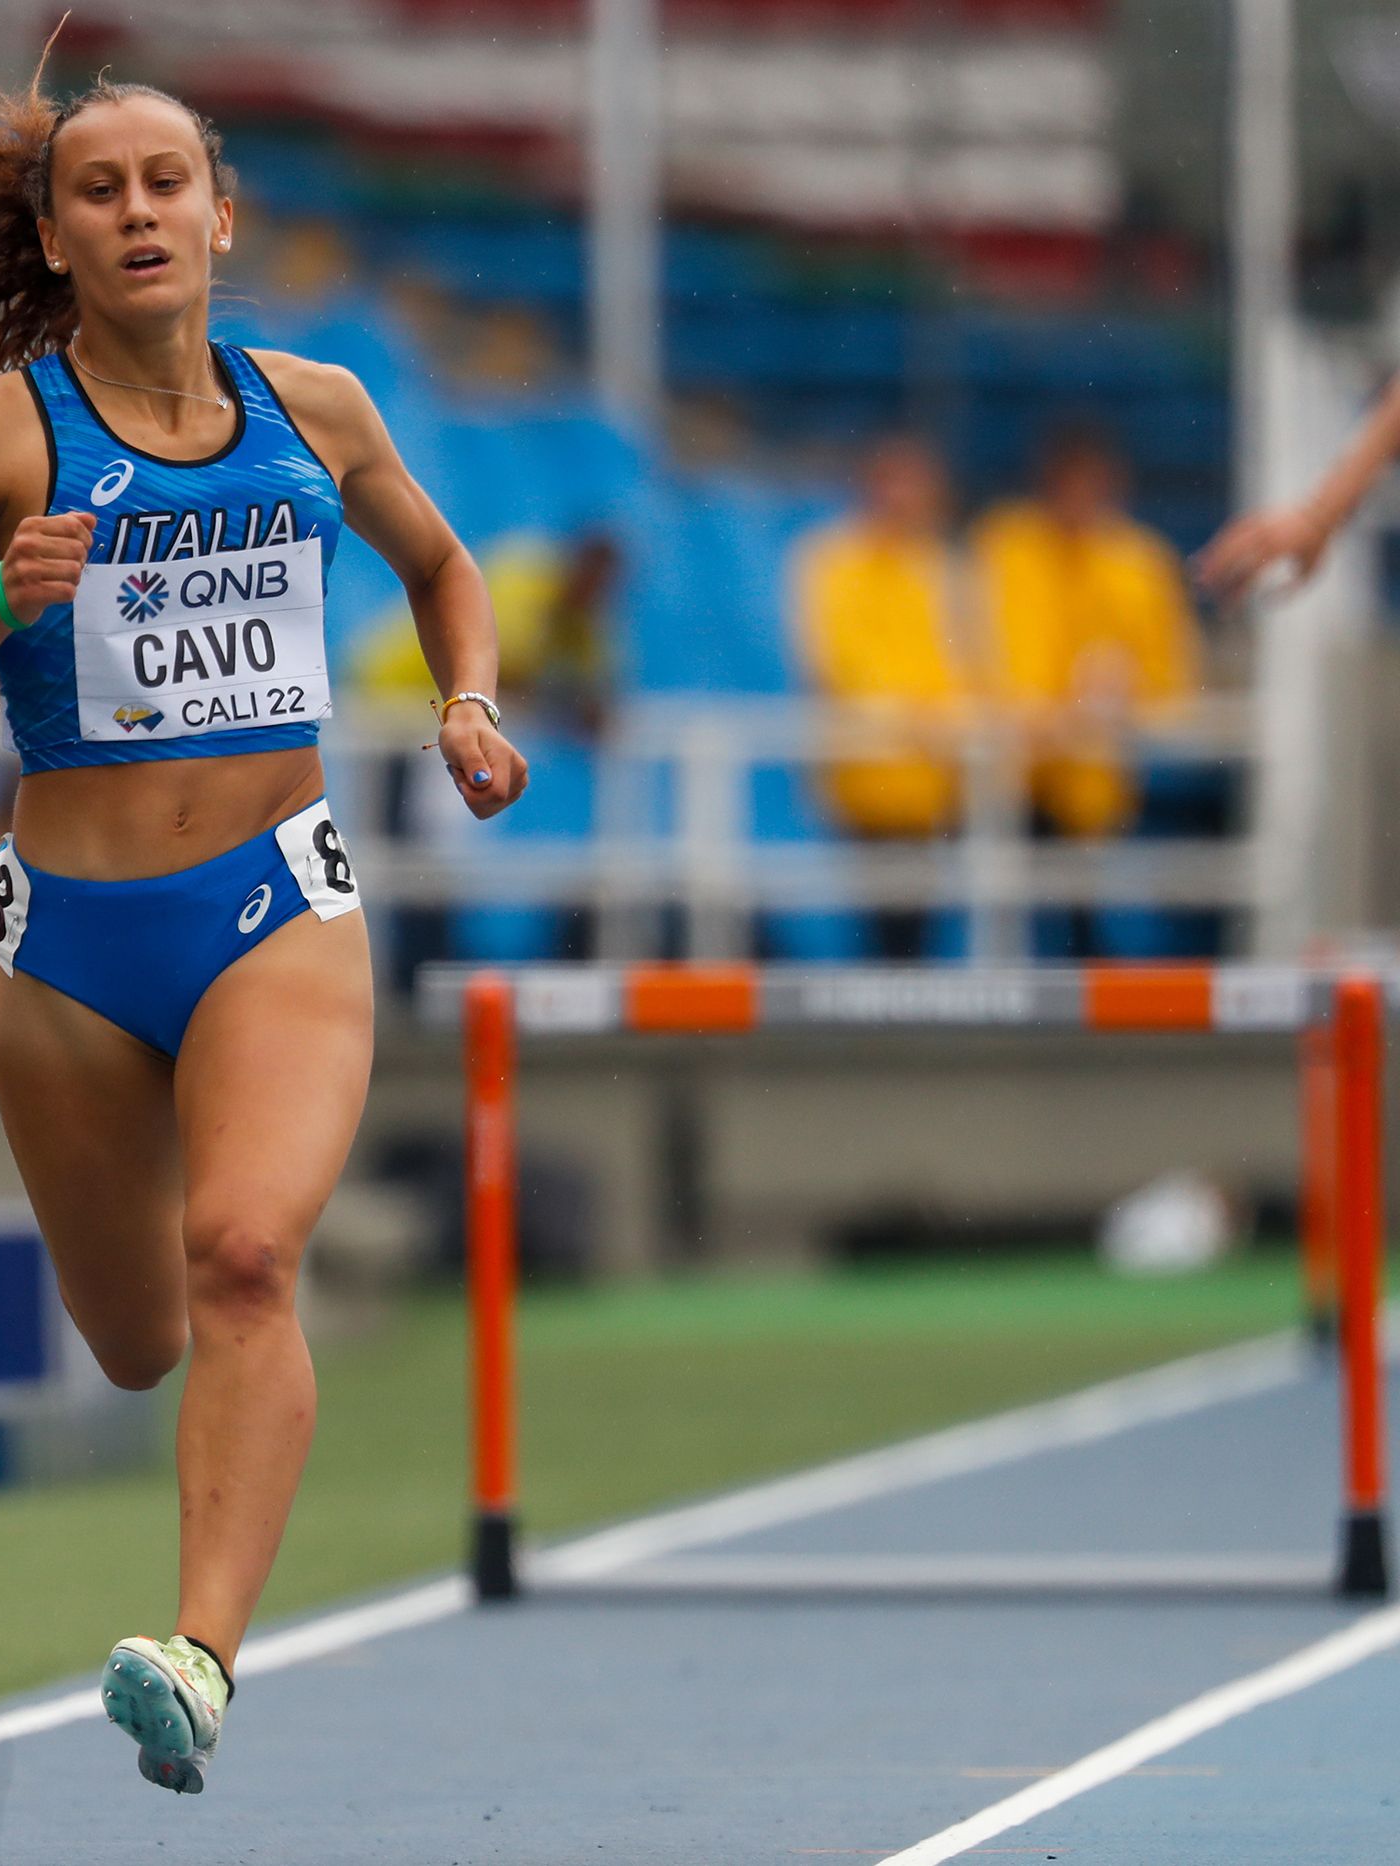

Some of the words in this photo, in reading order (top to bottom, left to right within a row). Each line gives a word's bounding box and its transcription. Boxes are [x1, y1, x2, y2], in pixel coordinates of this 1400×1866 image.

[108, 501, 298, 564] ITALIA
[180, 560, 289, 609] QNB
[133, 618, 276, 688] CAVO
[181, 692, 258, 727] CALI
[267, 686, 305, 715] 22
[312, 819, 355, 894] 8
